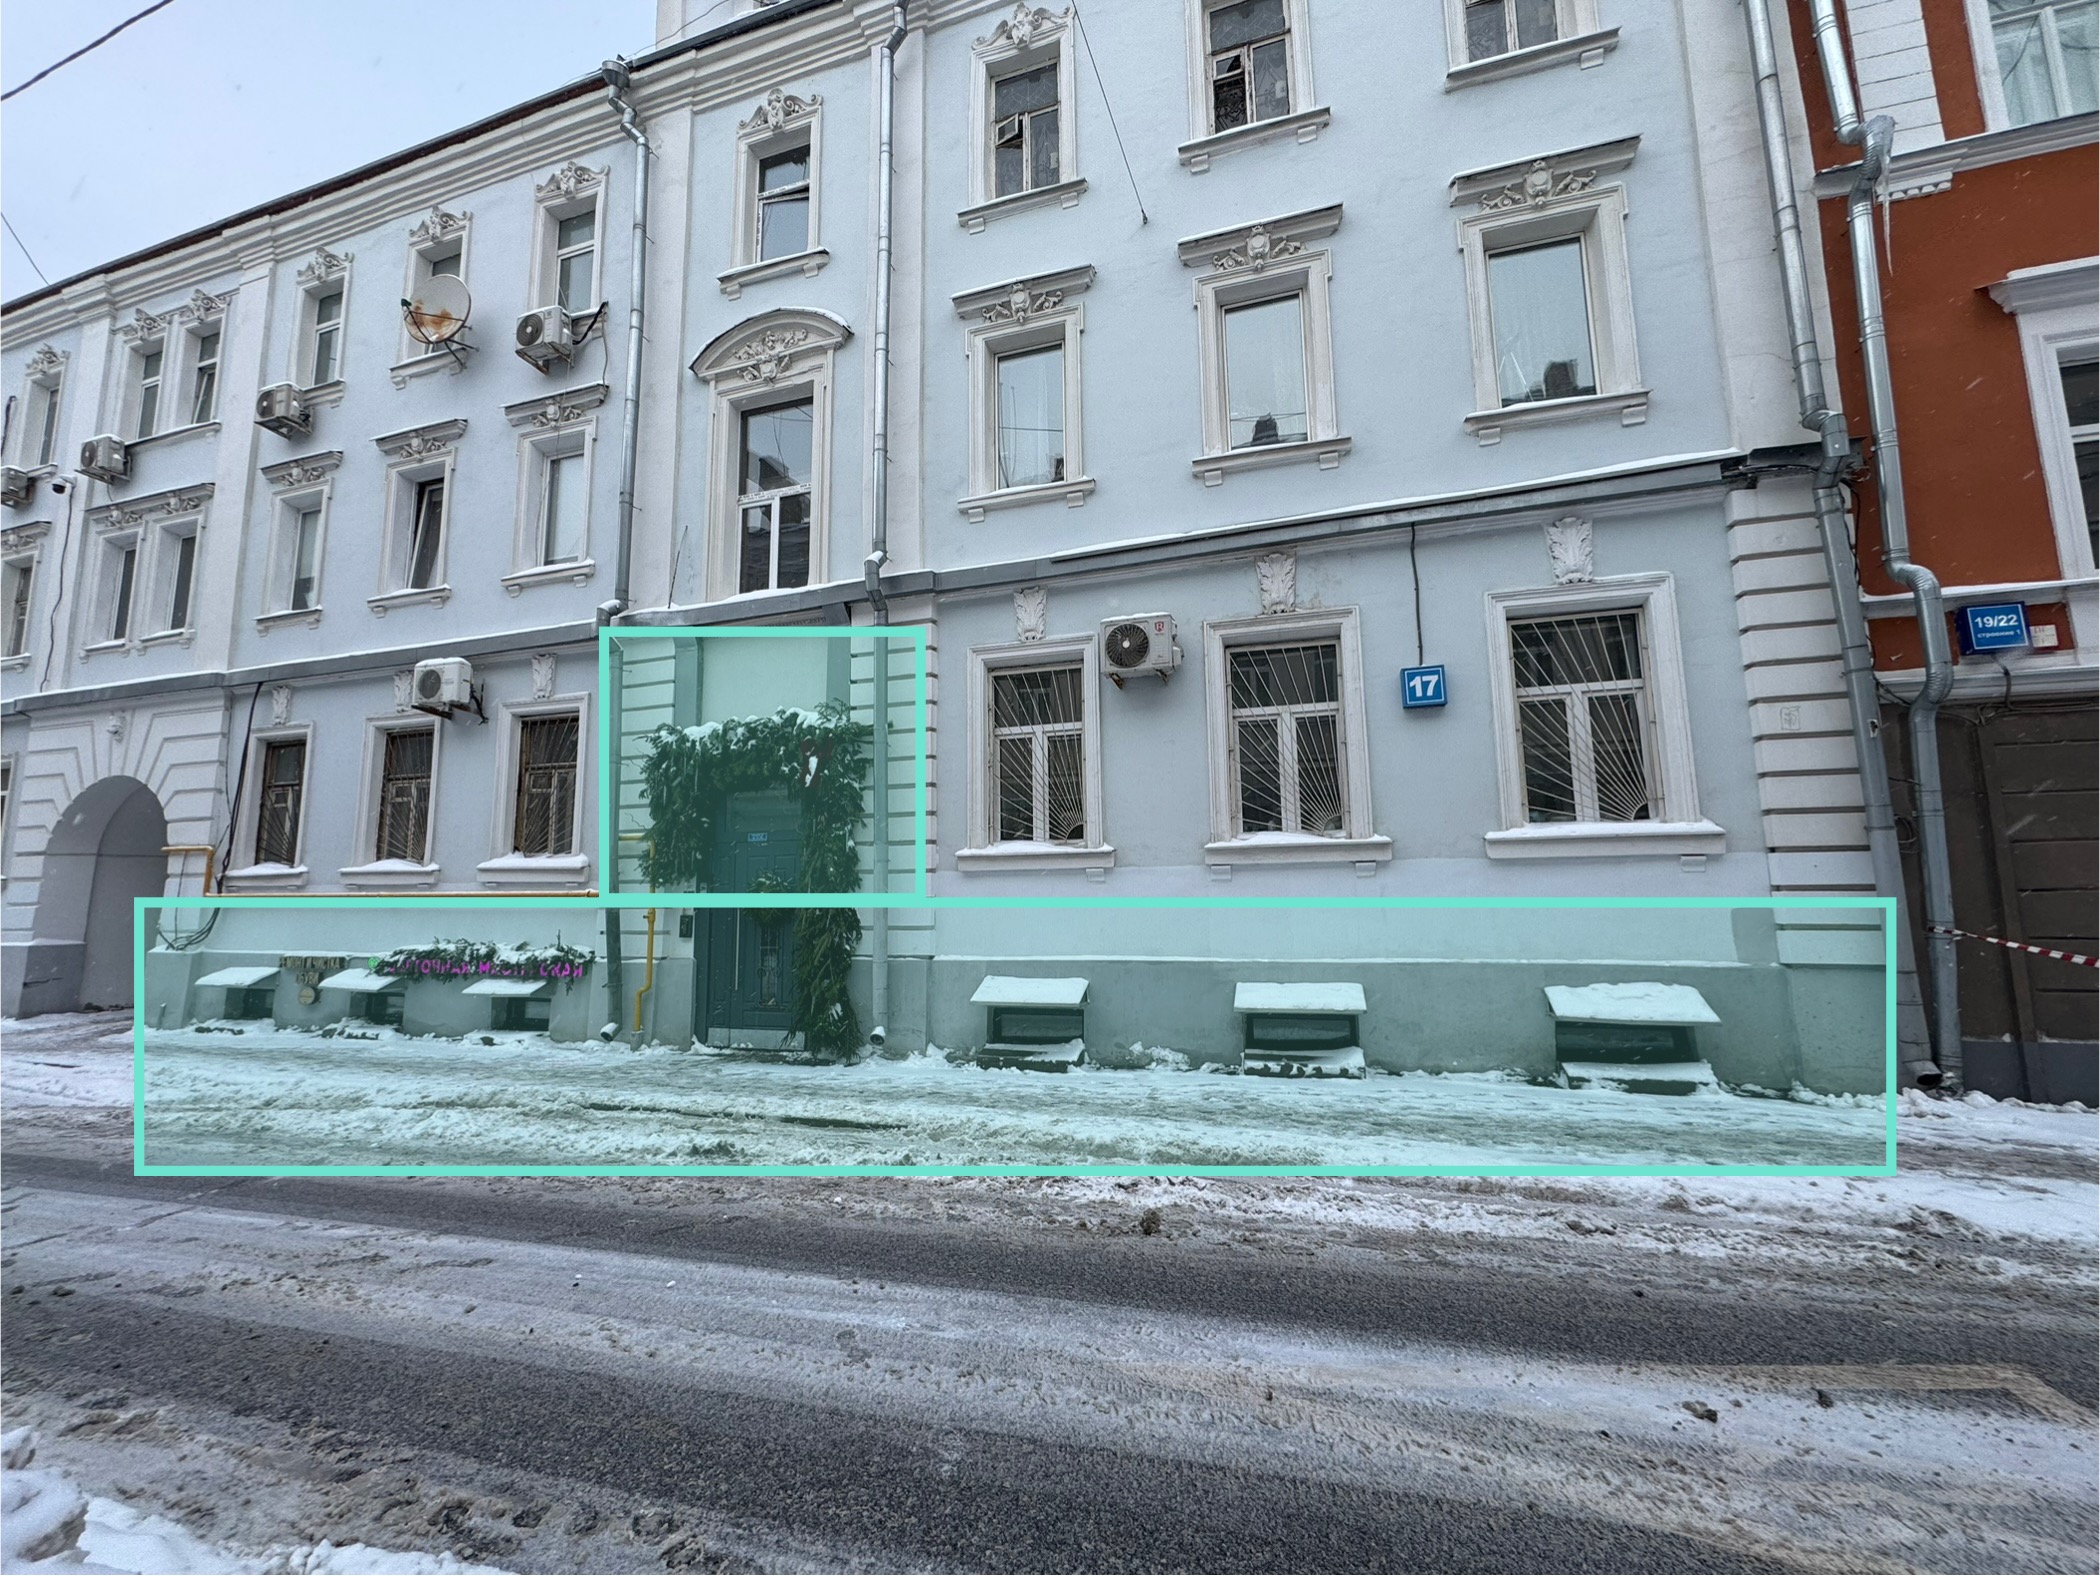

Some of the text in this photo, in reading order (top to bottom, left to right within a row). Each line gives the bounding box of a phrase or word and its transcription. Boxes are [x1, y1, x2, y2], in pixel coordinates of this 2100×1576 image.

[1974, 614, 2019, 628] 19/22
[1977, 630, 2015, 638] строение
[1409, 674, 1439, 697] 17
